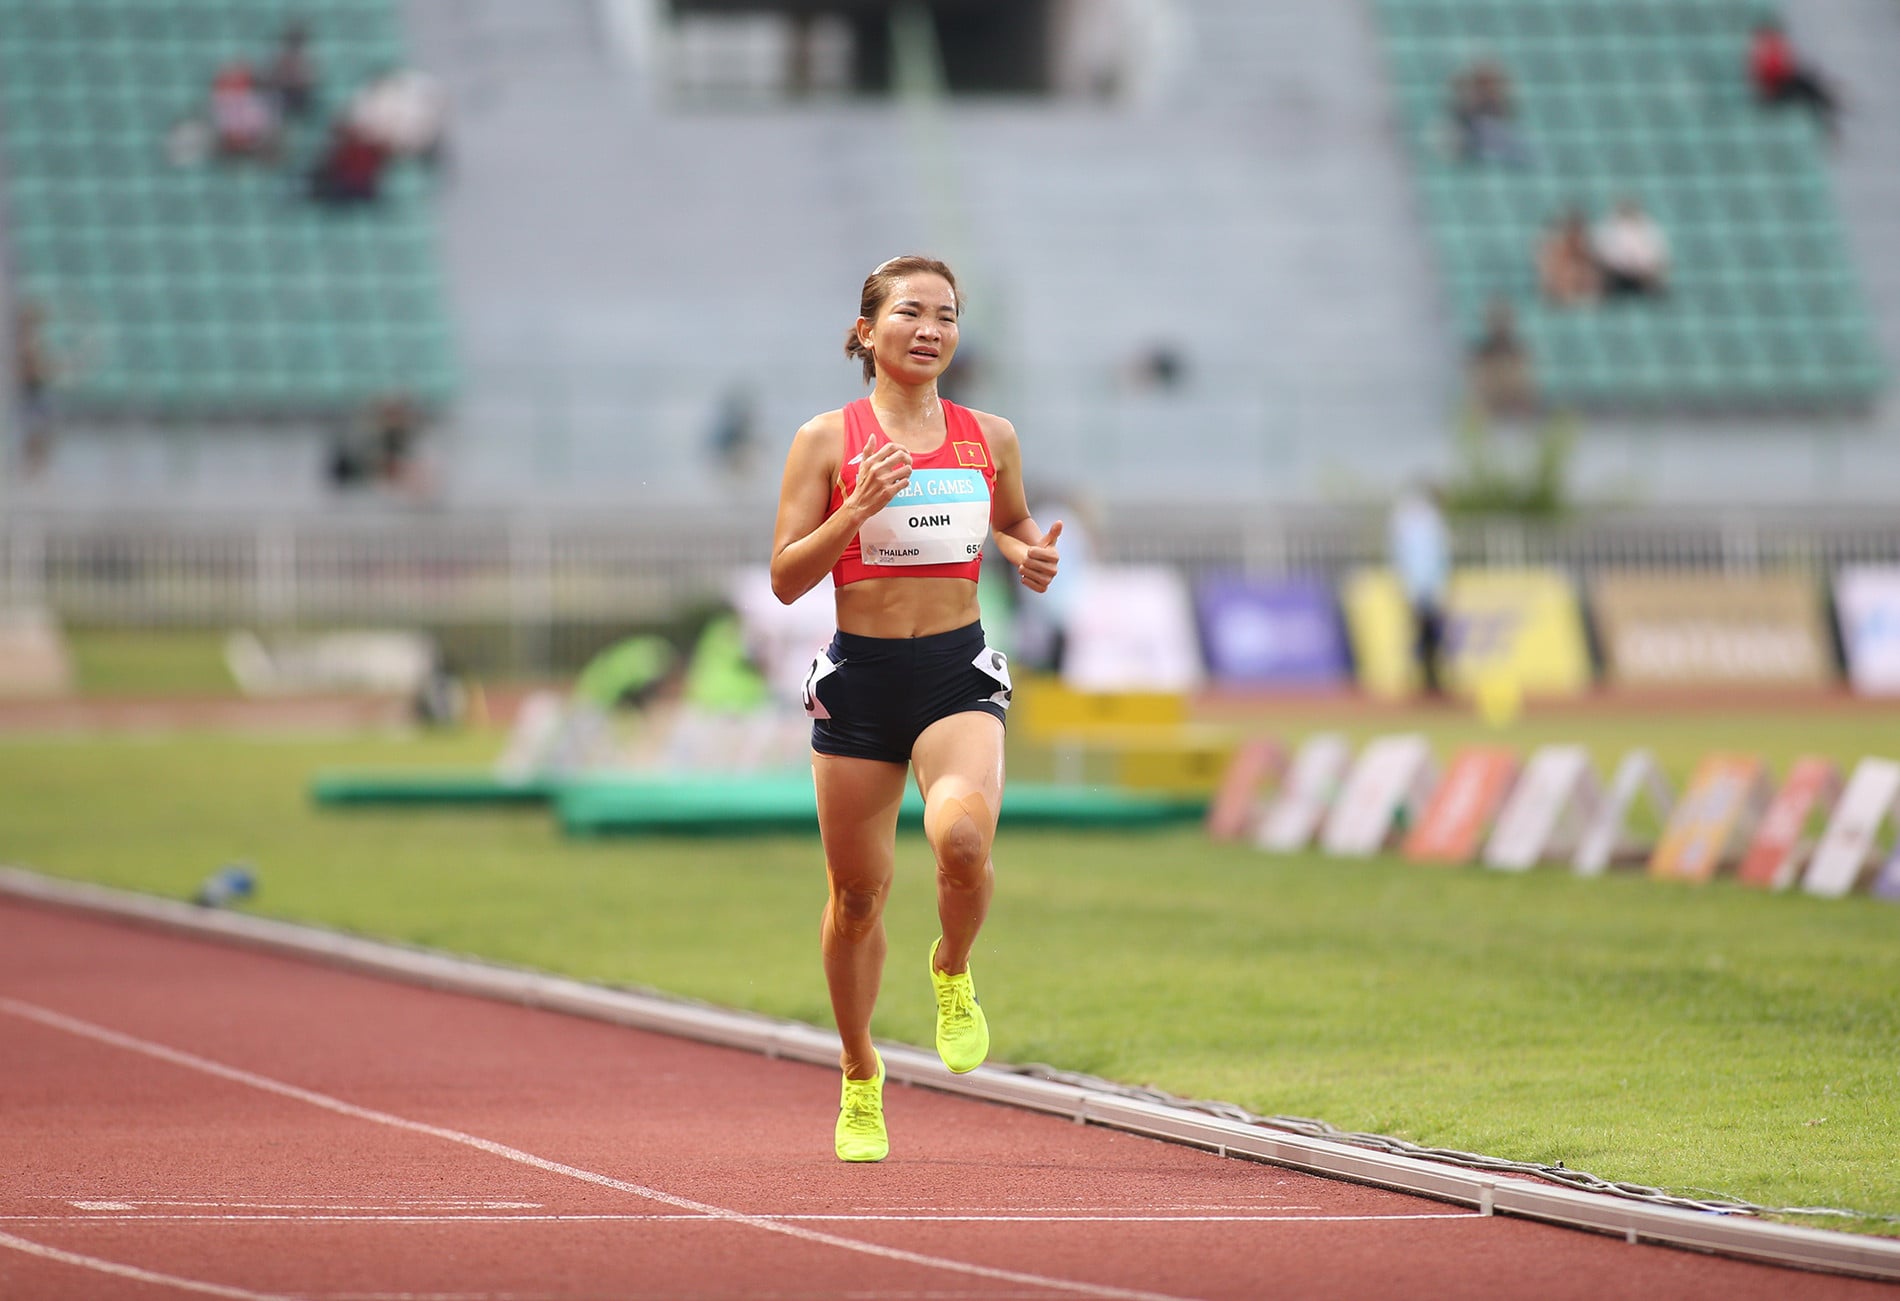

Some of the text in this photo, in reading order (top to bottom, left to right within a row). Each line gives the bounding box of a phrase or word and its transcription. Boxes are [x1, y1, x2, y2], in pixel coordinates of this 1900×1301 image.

[927, 480, 974, 496] GAMES
[909, 515, 951, 528] OANH
[879, 548, 920, 556] THAILAND
